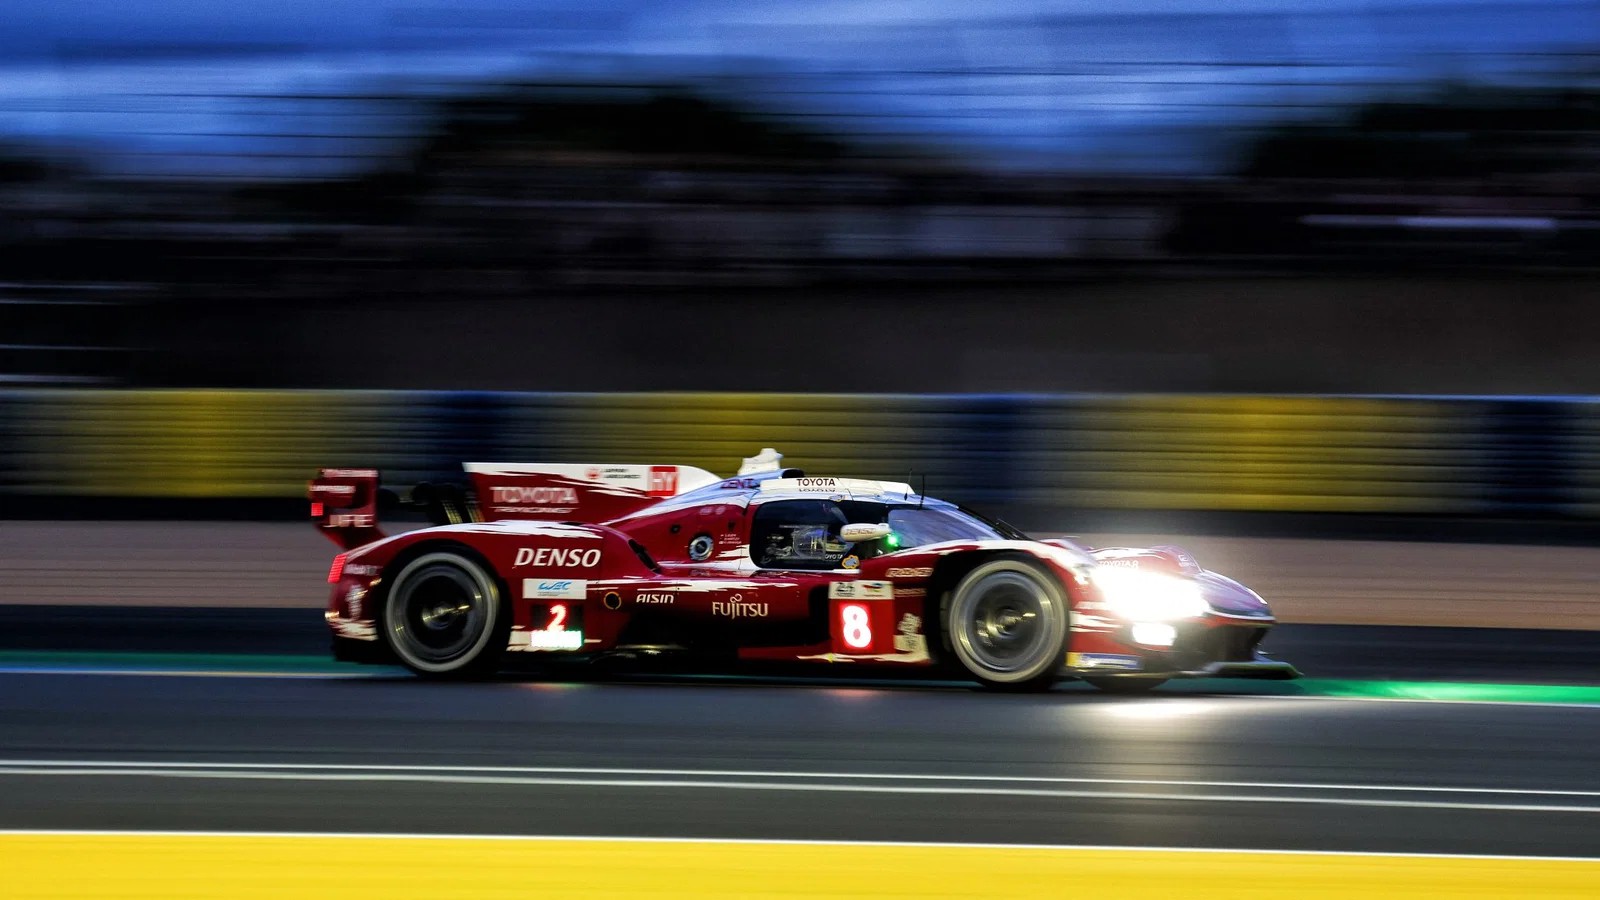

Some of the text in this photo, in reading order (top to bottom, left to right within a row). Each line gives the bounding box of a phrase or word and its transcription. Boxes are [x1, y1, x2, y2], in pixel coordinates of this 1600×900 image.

[648, 472, 677, 491] HY
[796, 478, 836, 487] TOYOTA
[489, 486, 579, 503] TOYOTA
[515, 548, 601, 567] DENSO
[538, 581, 573, 590] WEC
[636, 594, 674, 604] AISIN
[712, 593, 768, 619] FUJITSU
[547, 604, 566, 632] 2
[843, 605, 871, 648] 8
